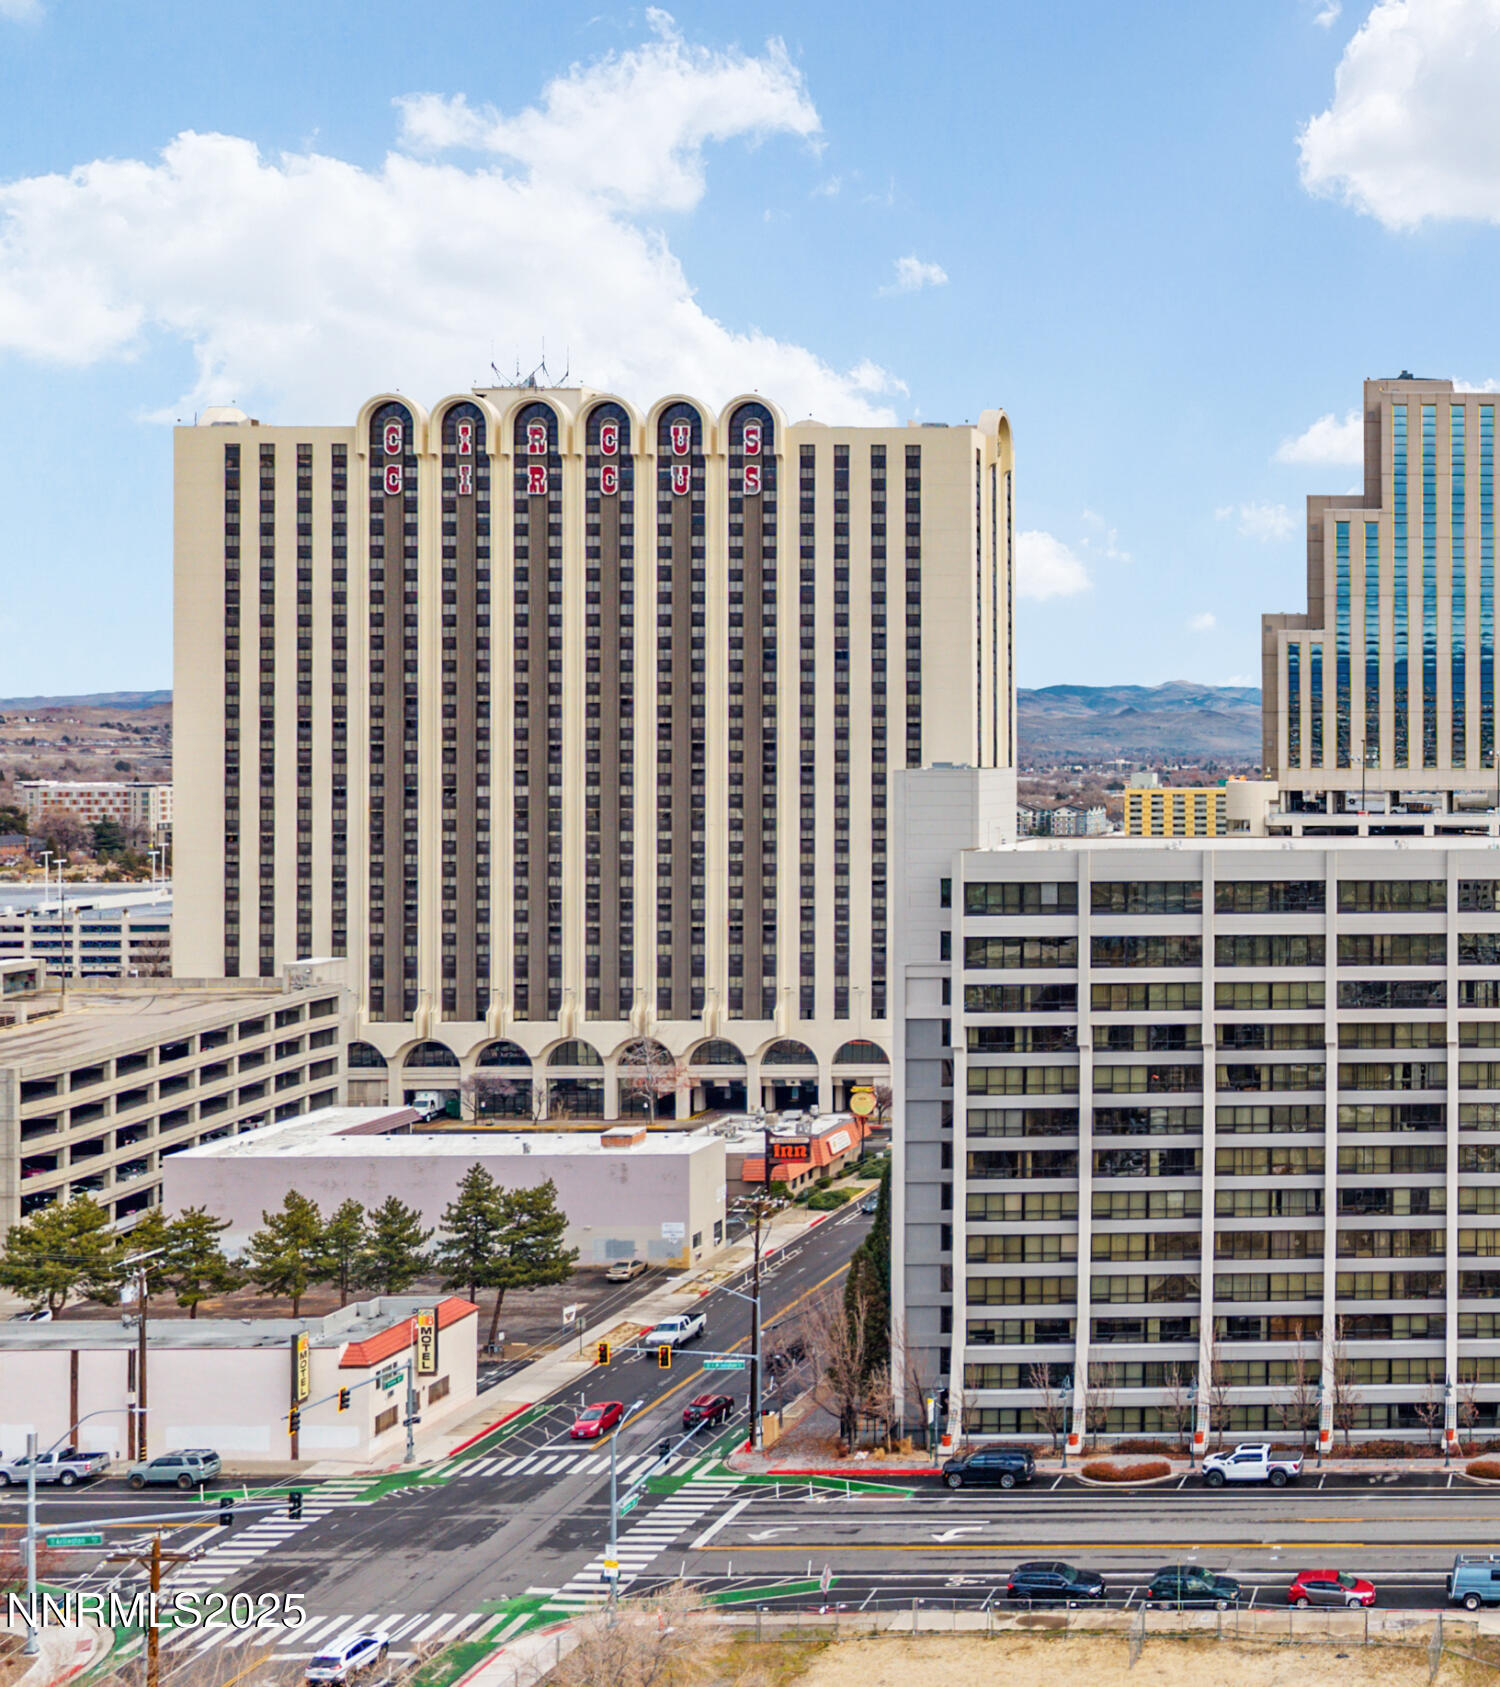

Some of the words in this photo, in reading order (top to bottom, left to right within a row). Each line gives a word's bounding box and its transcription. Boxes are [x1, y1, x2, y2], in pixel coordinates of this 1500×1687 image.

[383, 424, 761, 456] CIRCUS
[383, 464, 761, 495] CIRCUS
[420, 1326, 432, 1369] MOTEL
